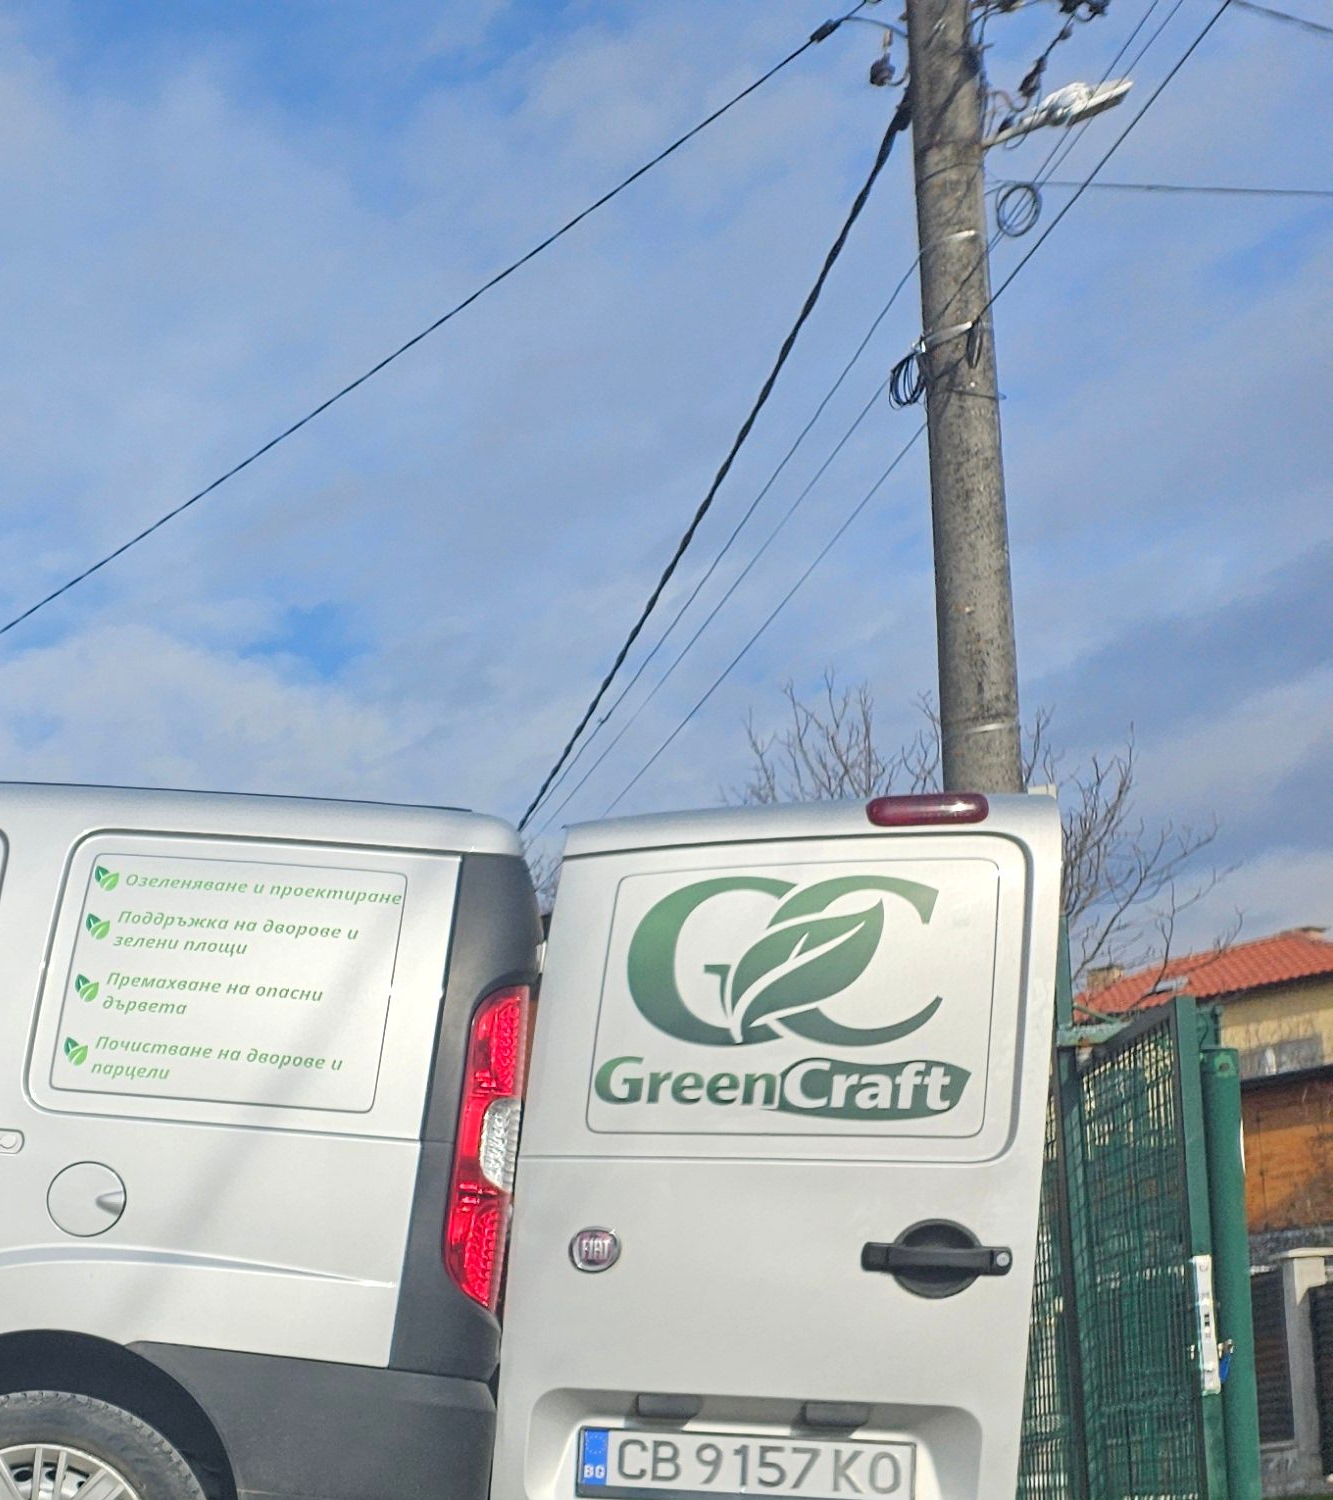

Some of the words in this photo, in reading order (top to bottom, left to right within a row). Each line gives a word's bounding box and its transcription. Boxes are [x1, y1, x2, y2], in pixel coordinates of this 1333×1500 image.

[125, 873, 248, 894] Озеленяване
[253, 882, 265, 895] и
[269, 883, 403, 906] проектиране
[117, 910, 229, 931] Поддръжка
[233, 919, 258, 933] на
[262, 919, 342, 940] дворове
[346, 928, 359, 941] и
[113, 935, 179, 951] зелени
[182, 939, 248, 958] площи
[106, 971, 222, 994] Премахване
[225, 981, 251, 996] на
[254, 985, 324, 1003] опасни
[102, 995, 188, 1016] дървета
[95, 1035, 213, 1060] Почистване
[217, 1047, 242, 1062] на
[246, 1047, 327, 1071] дворове
[330, 1056, 344, 1072] и
[91, 1061, 171, 1080] парцели
[594, 1056, 952, 1111] GreenCraft
[581, 1237, 612, 1262] FIAT
[583, 1463, 606, 1479] BG
[617, 1438, 682, 1483] CB
[695, 1442, 821, 1490] 9157
